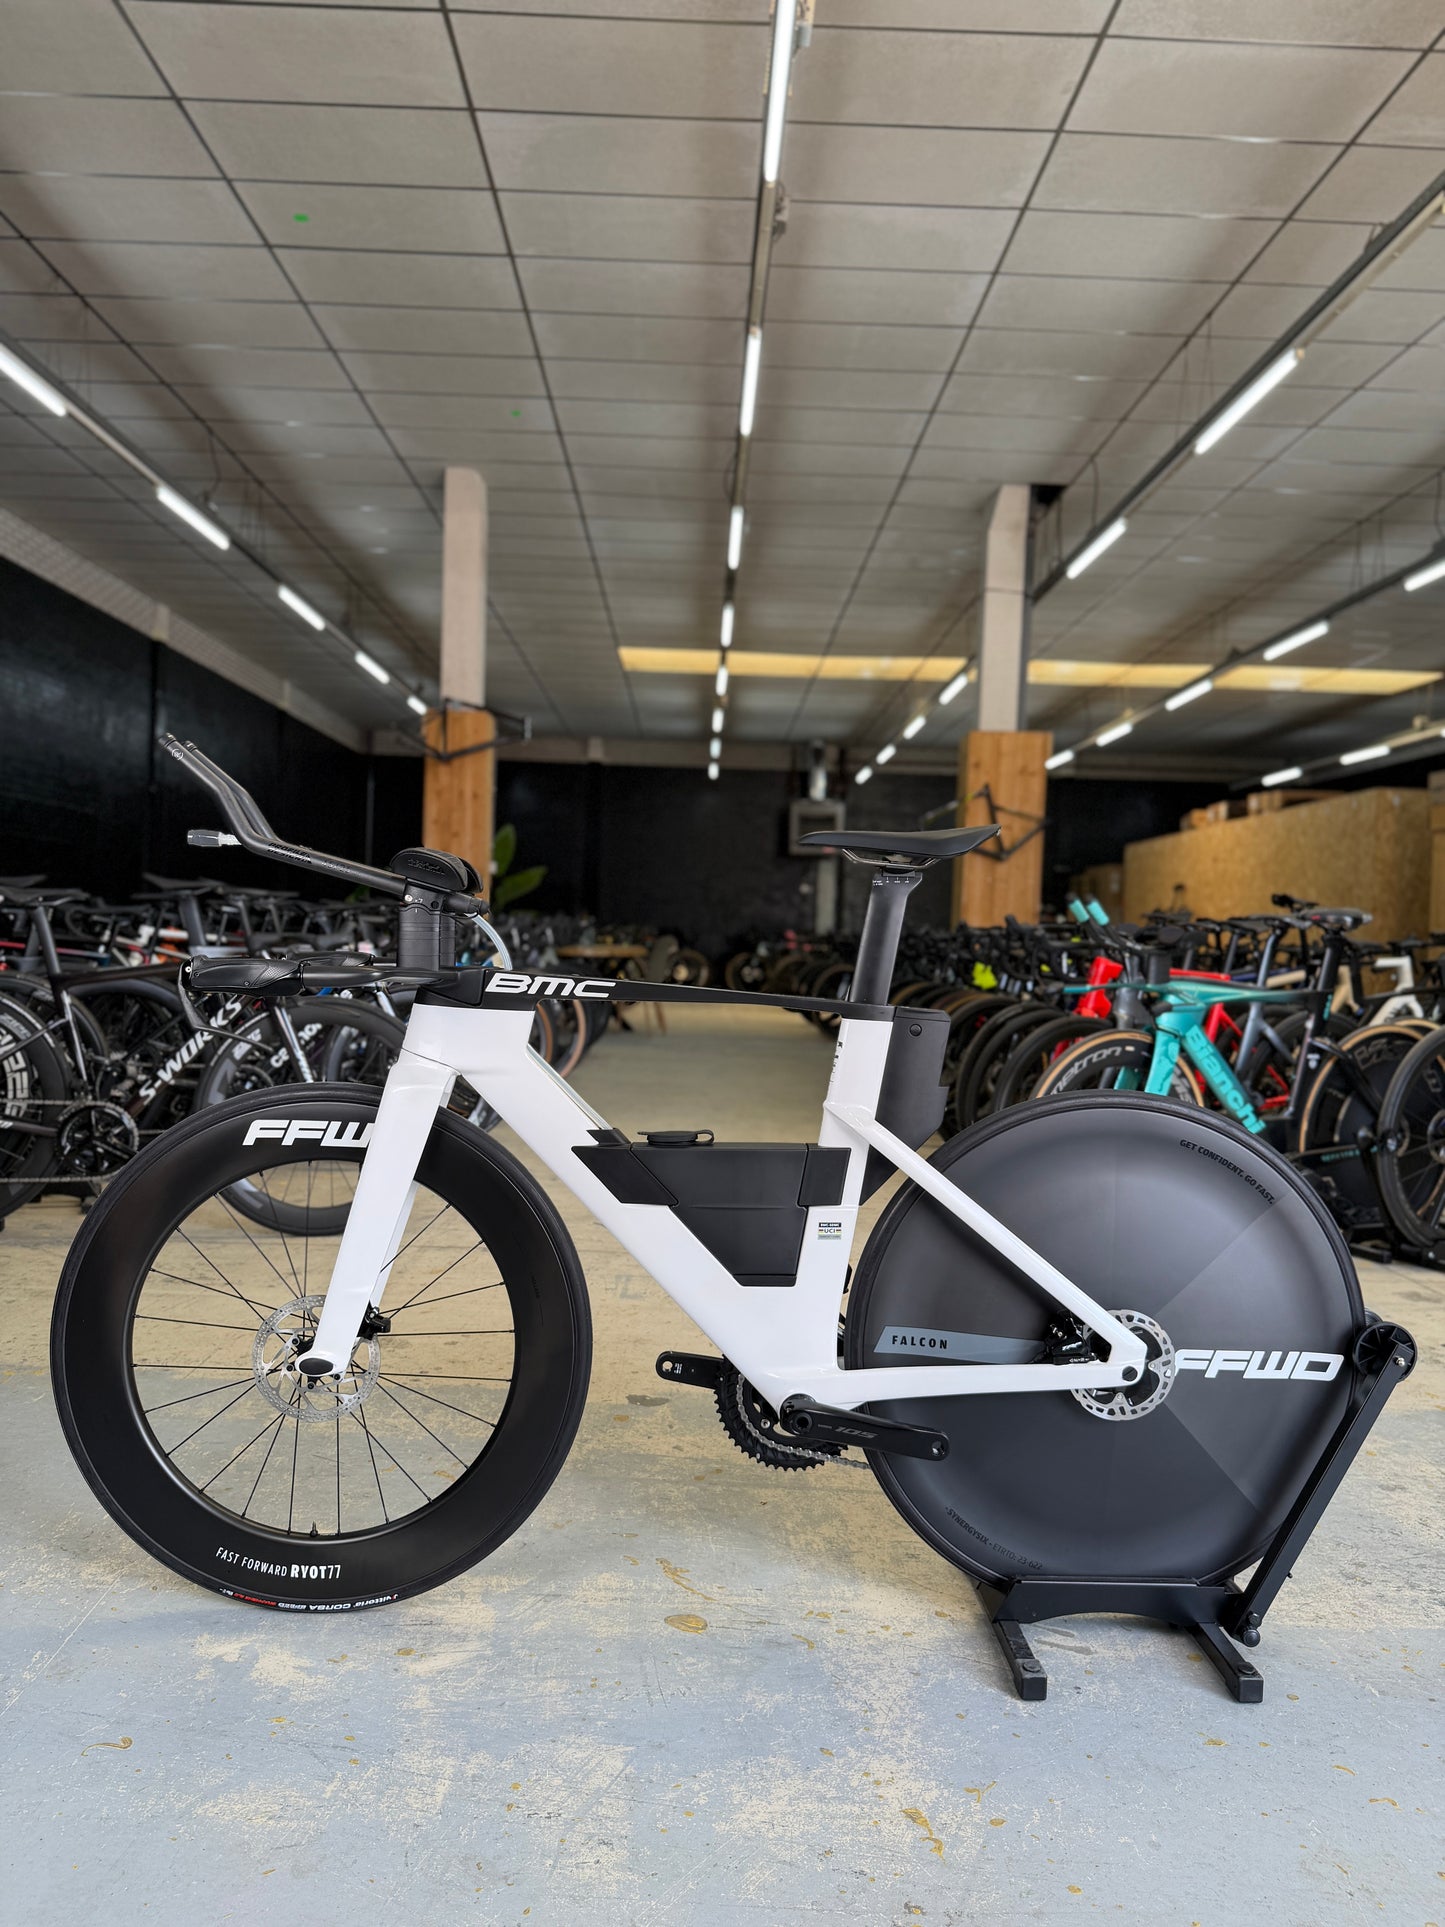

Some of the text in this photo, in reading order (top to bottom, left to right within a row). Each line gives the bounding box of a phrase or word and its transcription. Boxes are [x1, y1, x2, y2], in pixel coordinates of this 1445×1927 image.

[485, 972, 616, 997] BMC
[139, 994, 242, 1105] S-WORKS
[1185, 1024, 1266, 1134] Bianchi
[242, 1119, 376, 1148] FFW
[1180, 1139, 1275, 1205] GET CONFIDENT. GO FAST.
[892, 1335, 947, 1349] FALCON
[1174, 1349, 1344, 1382] FFWD
[835, 1425, 879, 1439] 105
[215, 1547, 342, 1579] FAST FORWARD RYOT77
[309, 1603, 351, 1611] CORSA
